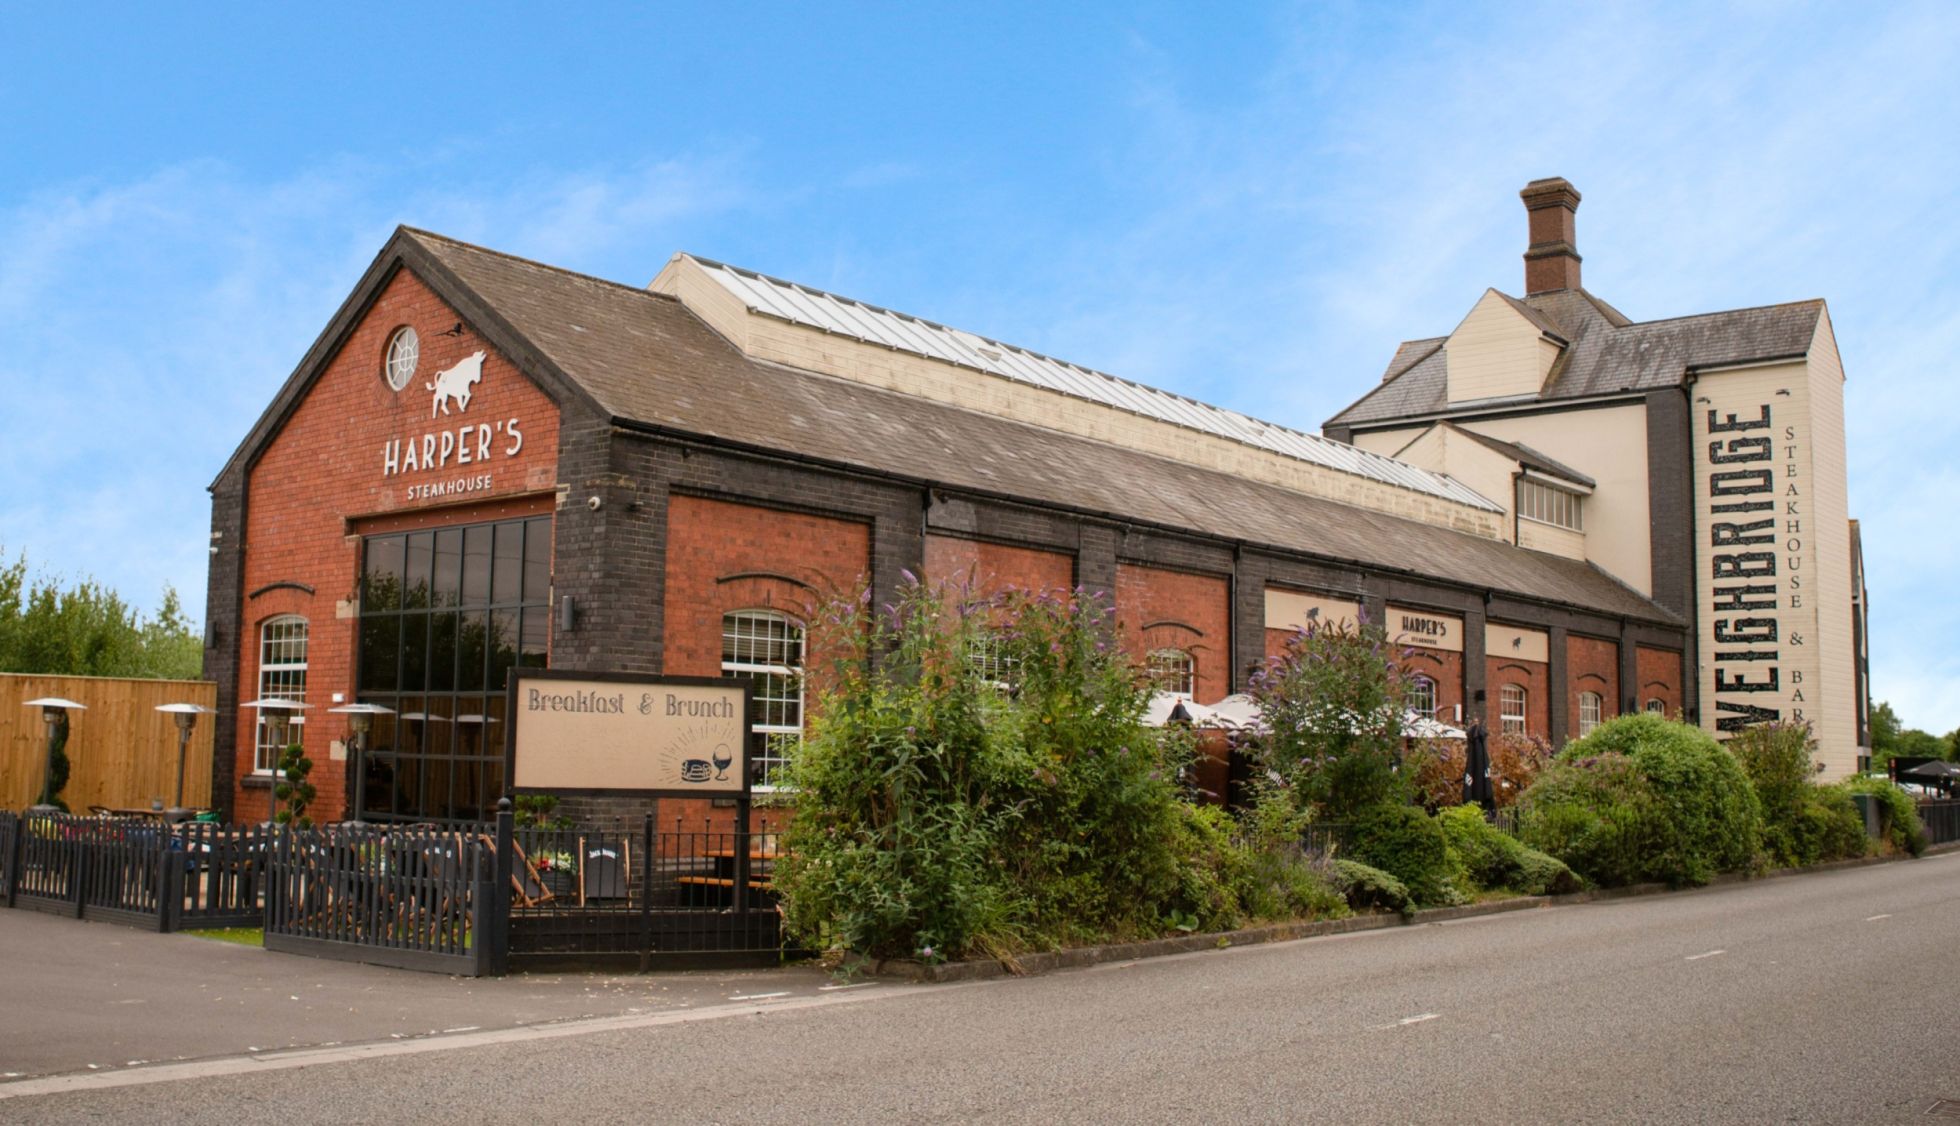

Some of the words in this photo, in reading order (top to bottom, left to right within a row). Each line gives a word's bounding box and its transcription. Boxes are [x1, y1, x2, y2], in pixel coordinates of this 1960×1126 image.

[384, 418, 523, 475] HARPER'S
[407, 474, 492, 500] STEAKHOUSE
[1784, 426, 1802, 609] STEAKHOUSE
[1402, 615, 1447, 637] HARPER'S
[1789, 632, 1804, 646] &
[528, 688, 625, 714] Breakfast
[637, 692, 654, 715] &
[665, 694, 734, 718] Brunch
[1791, 670, 1805, 721] BAR
